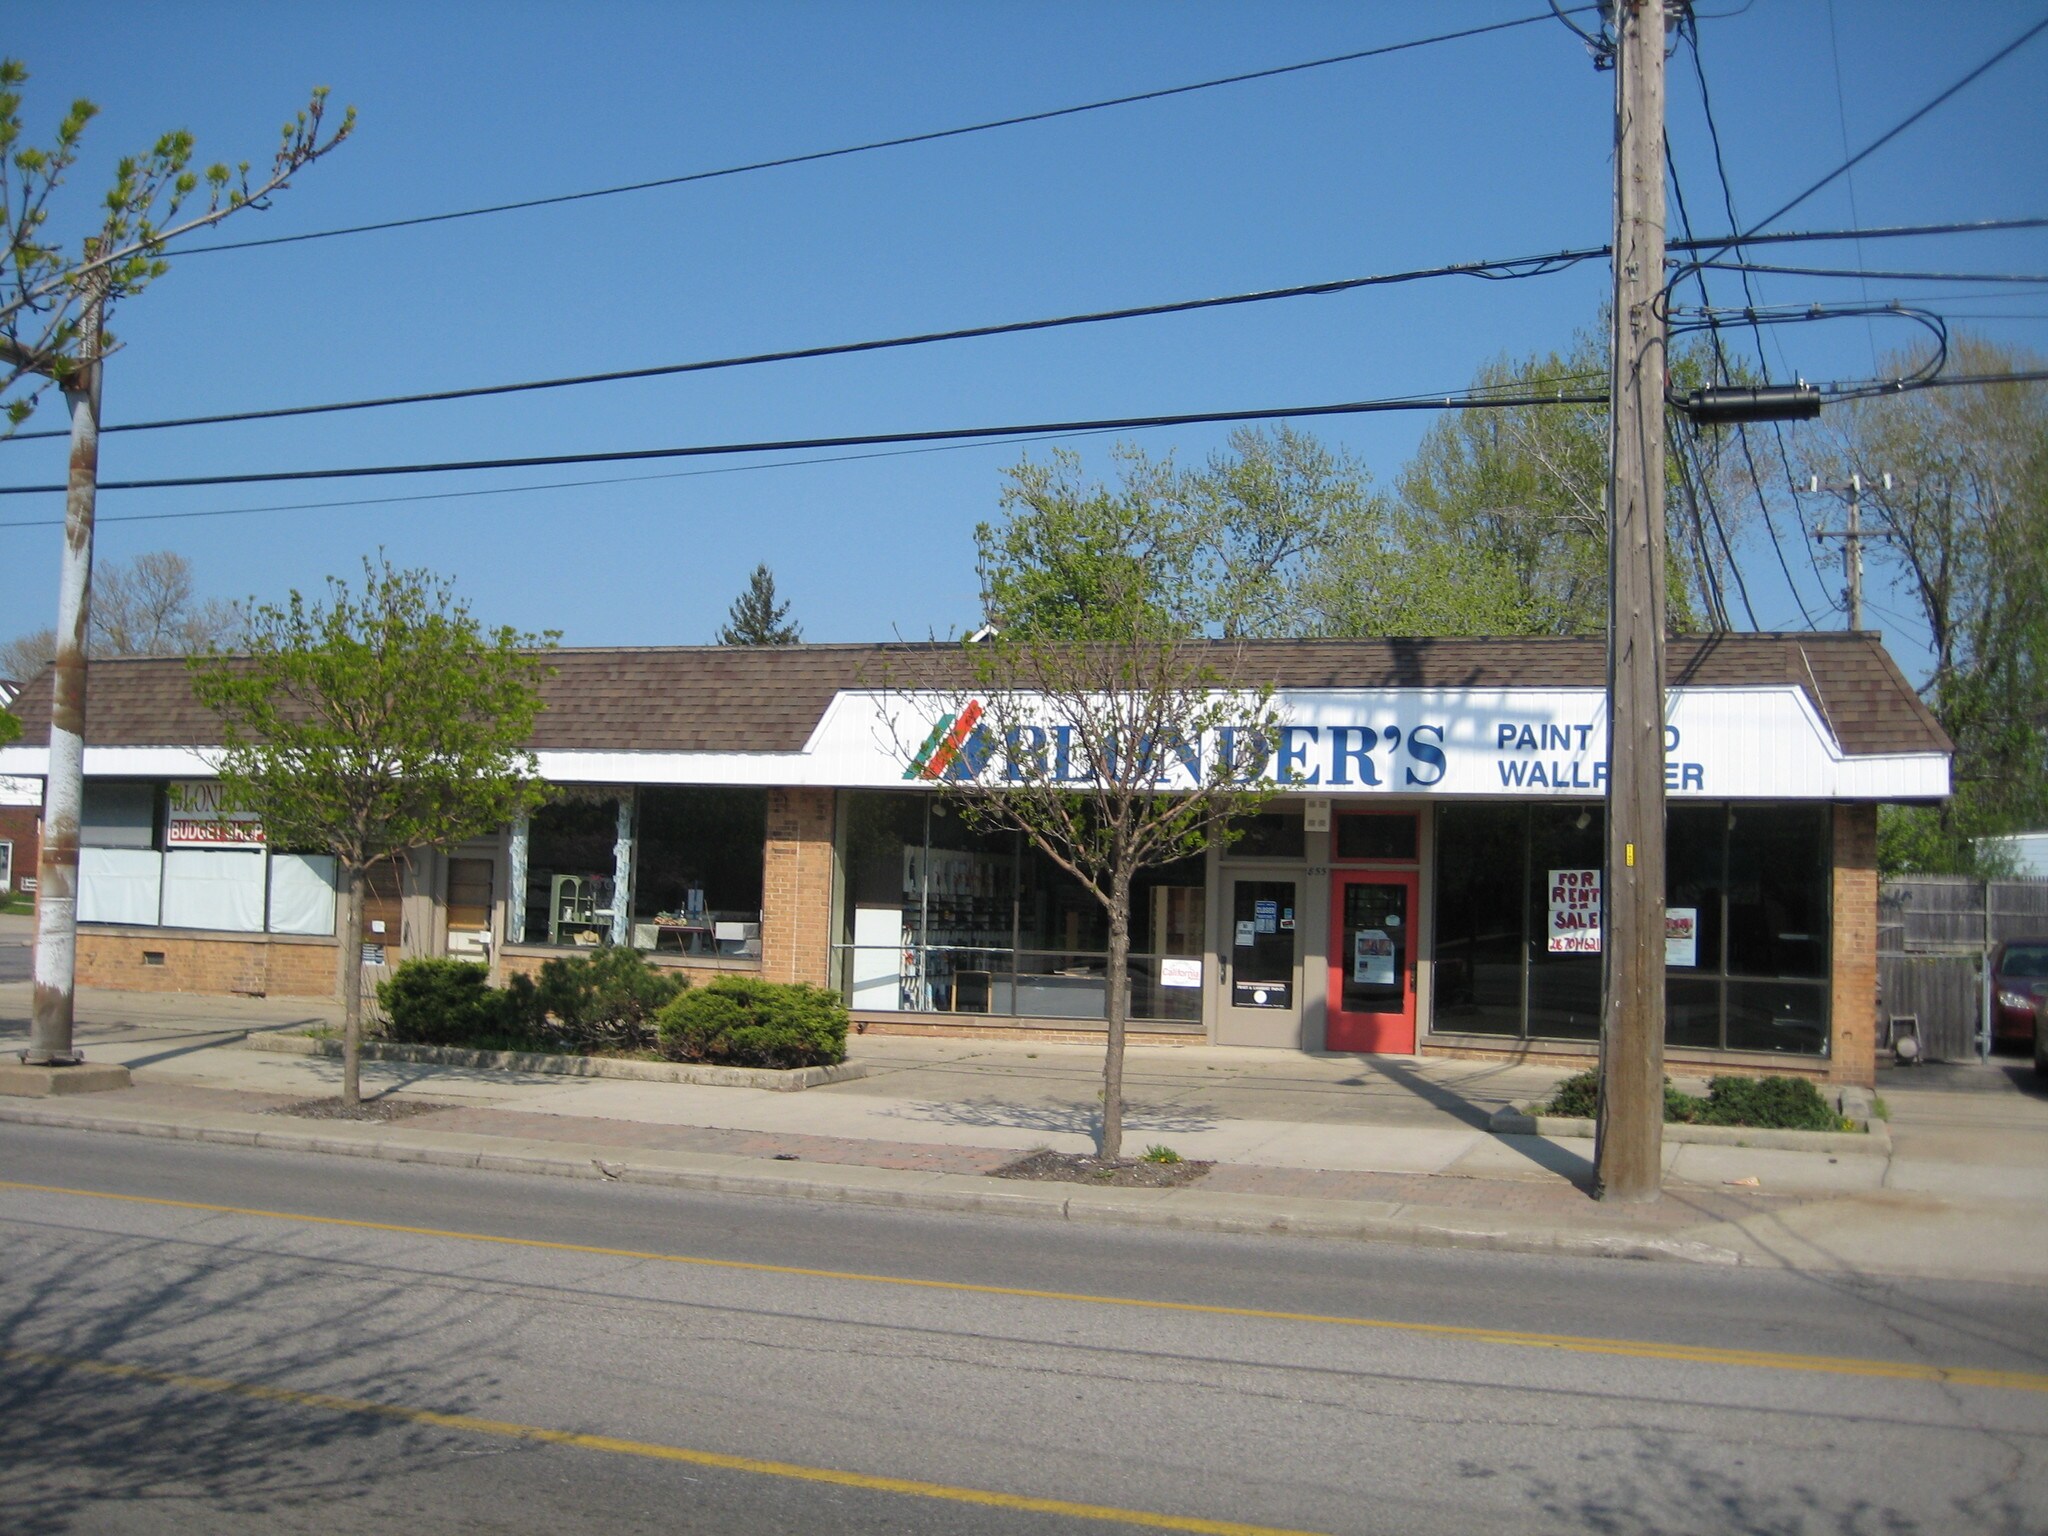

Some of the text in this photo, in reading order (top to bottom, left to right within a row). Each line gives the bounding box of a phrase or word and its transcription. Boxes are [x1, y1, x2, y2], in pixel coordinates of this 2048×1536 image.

[1497, 723, 1594, 751] PAINT
[1497, 760, 1705, 791] WALLPER
[1558, 871, 1594, 887] FOR
[1552, 886, 1600, 903] RENT
[1554, 911, 1598, 929] SALE
